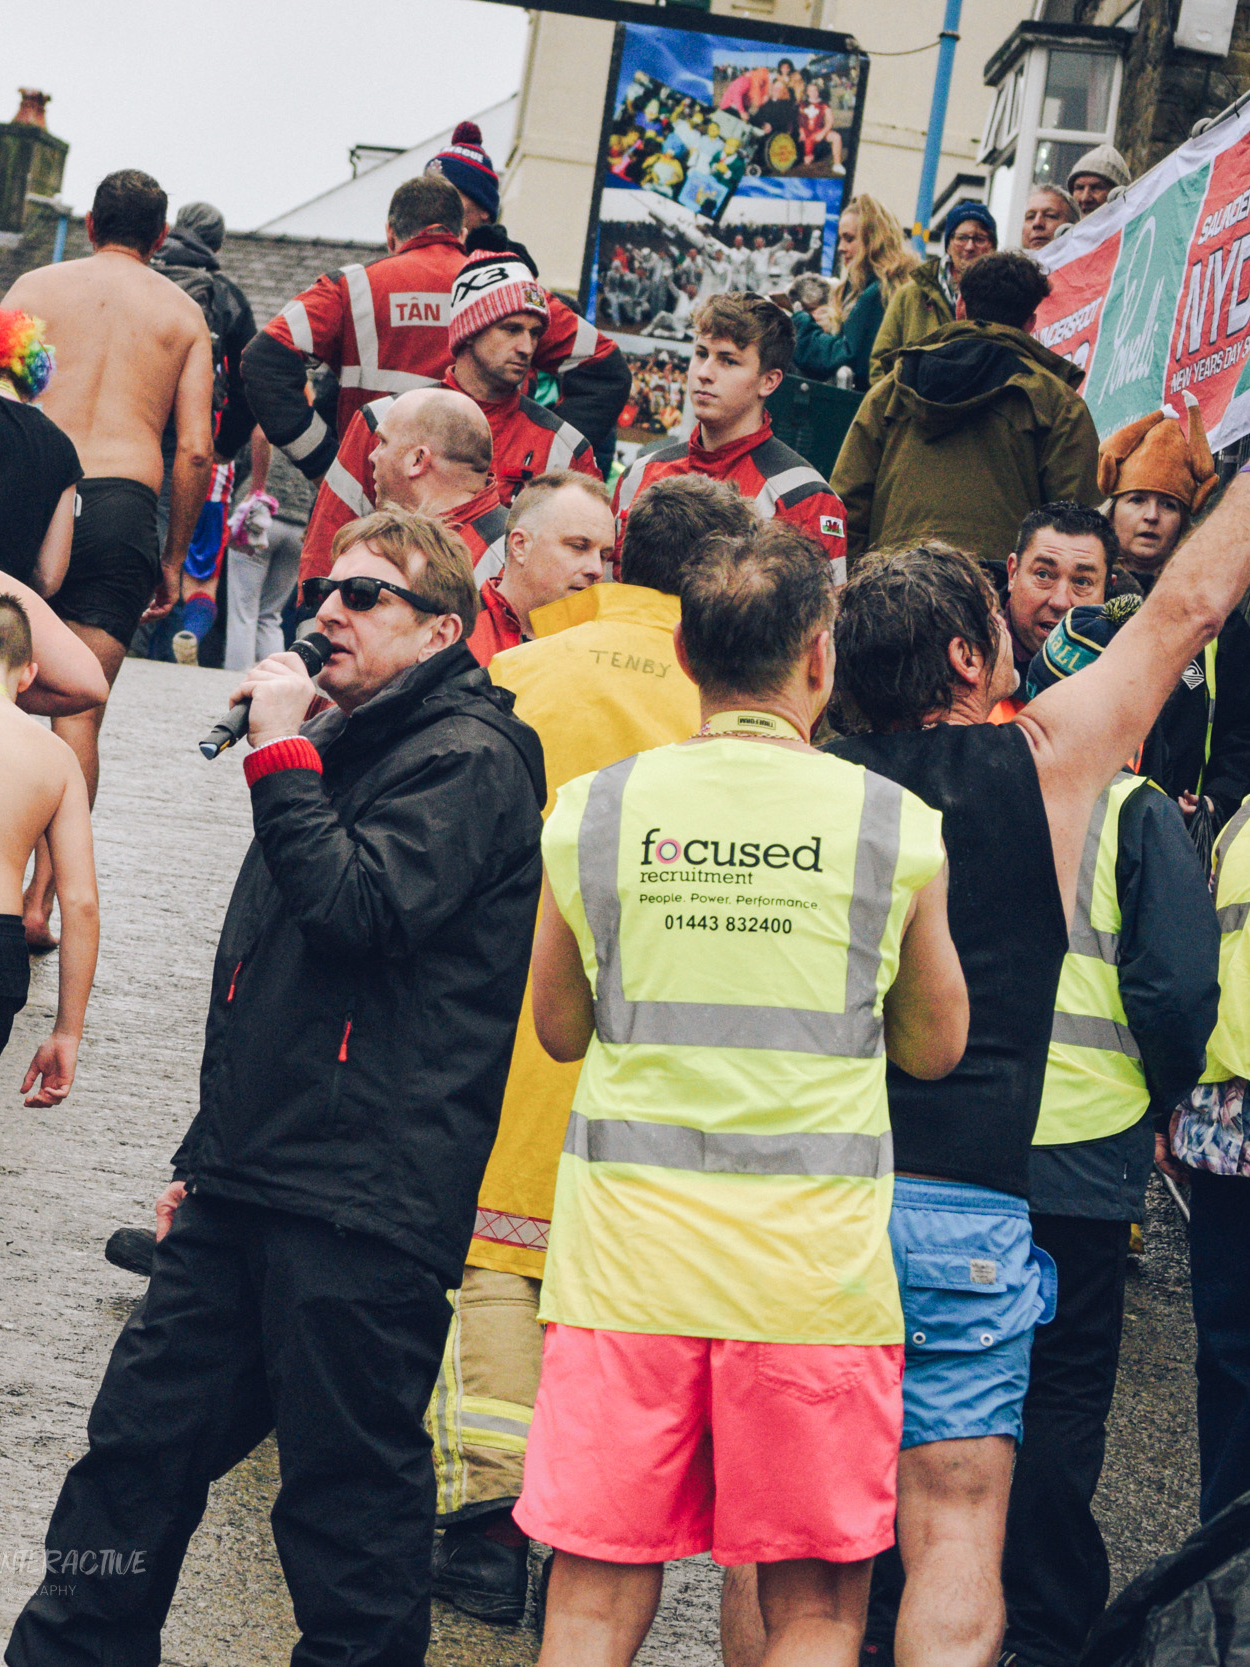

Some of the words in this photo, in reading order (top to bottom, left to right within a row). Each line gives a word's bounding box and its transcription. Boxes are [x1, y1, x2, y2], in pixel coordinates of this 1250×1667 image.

[1198, 188, 1250, 246] SAUNDE
[395, 296, 440, 321] TÂN
[1171, 363, 1192, 394] NEW
[1193, 352, 1223, 385] YEARS
[1224, 340, 1244, 369] DAY
[589, 650, 671, 678] TENBY
[640, 828, 823, 872] focused
[640, 867, 753, 885] recruitment
[639, 893, 686, 905] People.
[691, 893, 732, 905] Power.
[736, 895, 822, 911] Performance.
[665, 914, 719, 931] 01443
[726, 916, 792, 934] 832400
